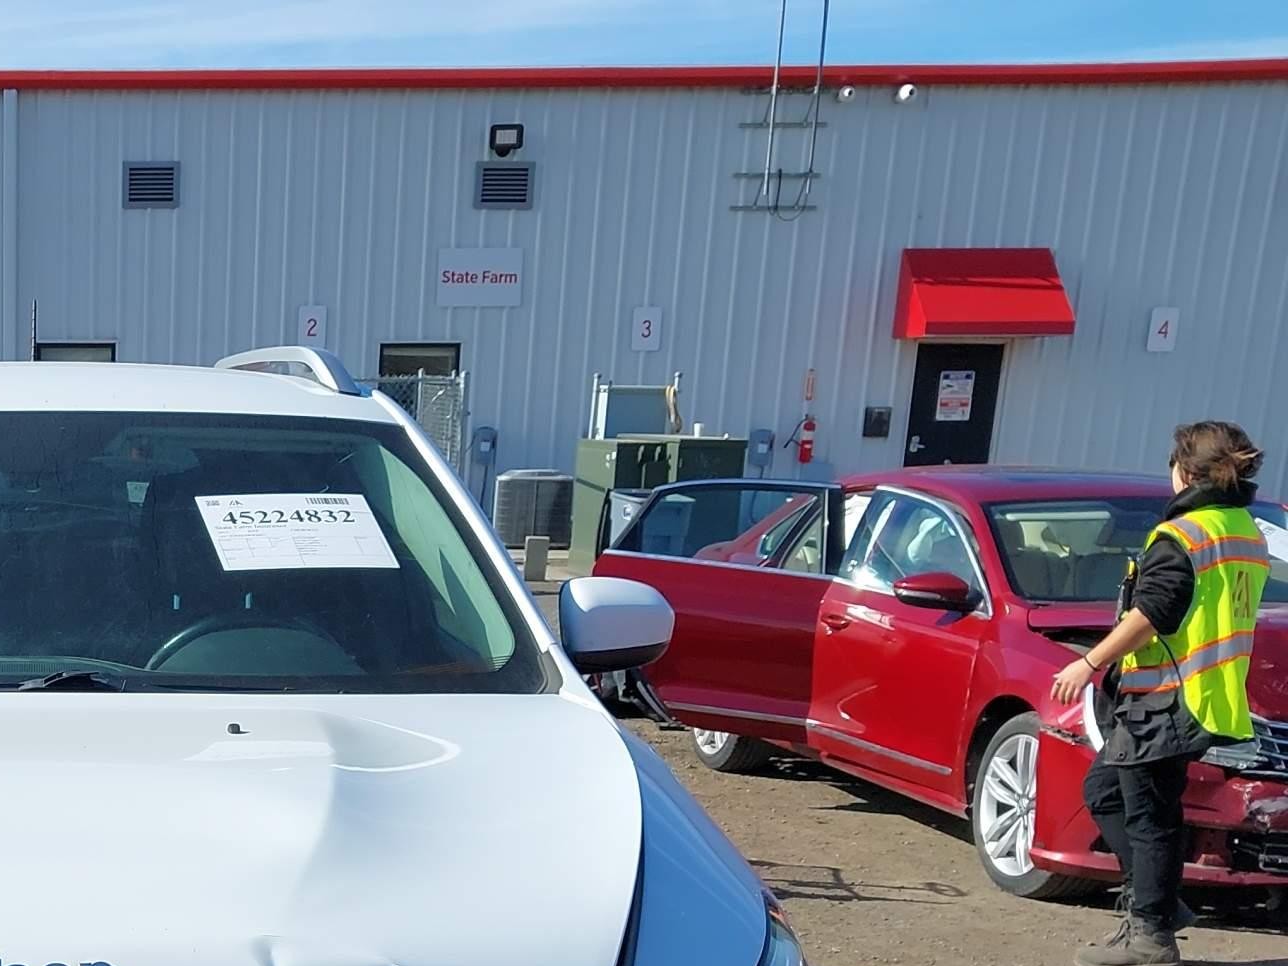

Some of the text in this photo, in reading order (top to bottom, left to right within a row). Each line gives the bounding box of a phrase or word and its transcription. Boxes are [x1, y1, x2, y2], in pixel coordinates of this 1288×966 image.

[441, 269, 519, 285] State Farm
[306, 317, 318, 337] 2
[640, 319, 652, 339] 3
[1157, 319, 1169, 339] 4
[222, 509, 356, 525] 45224832
